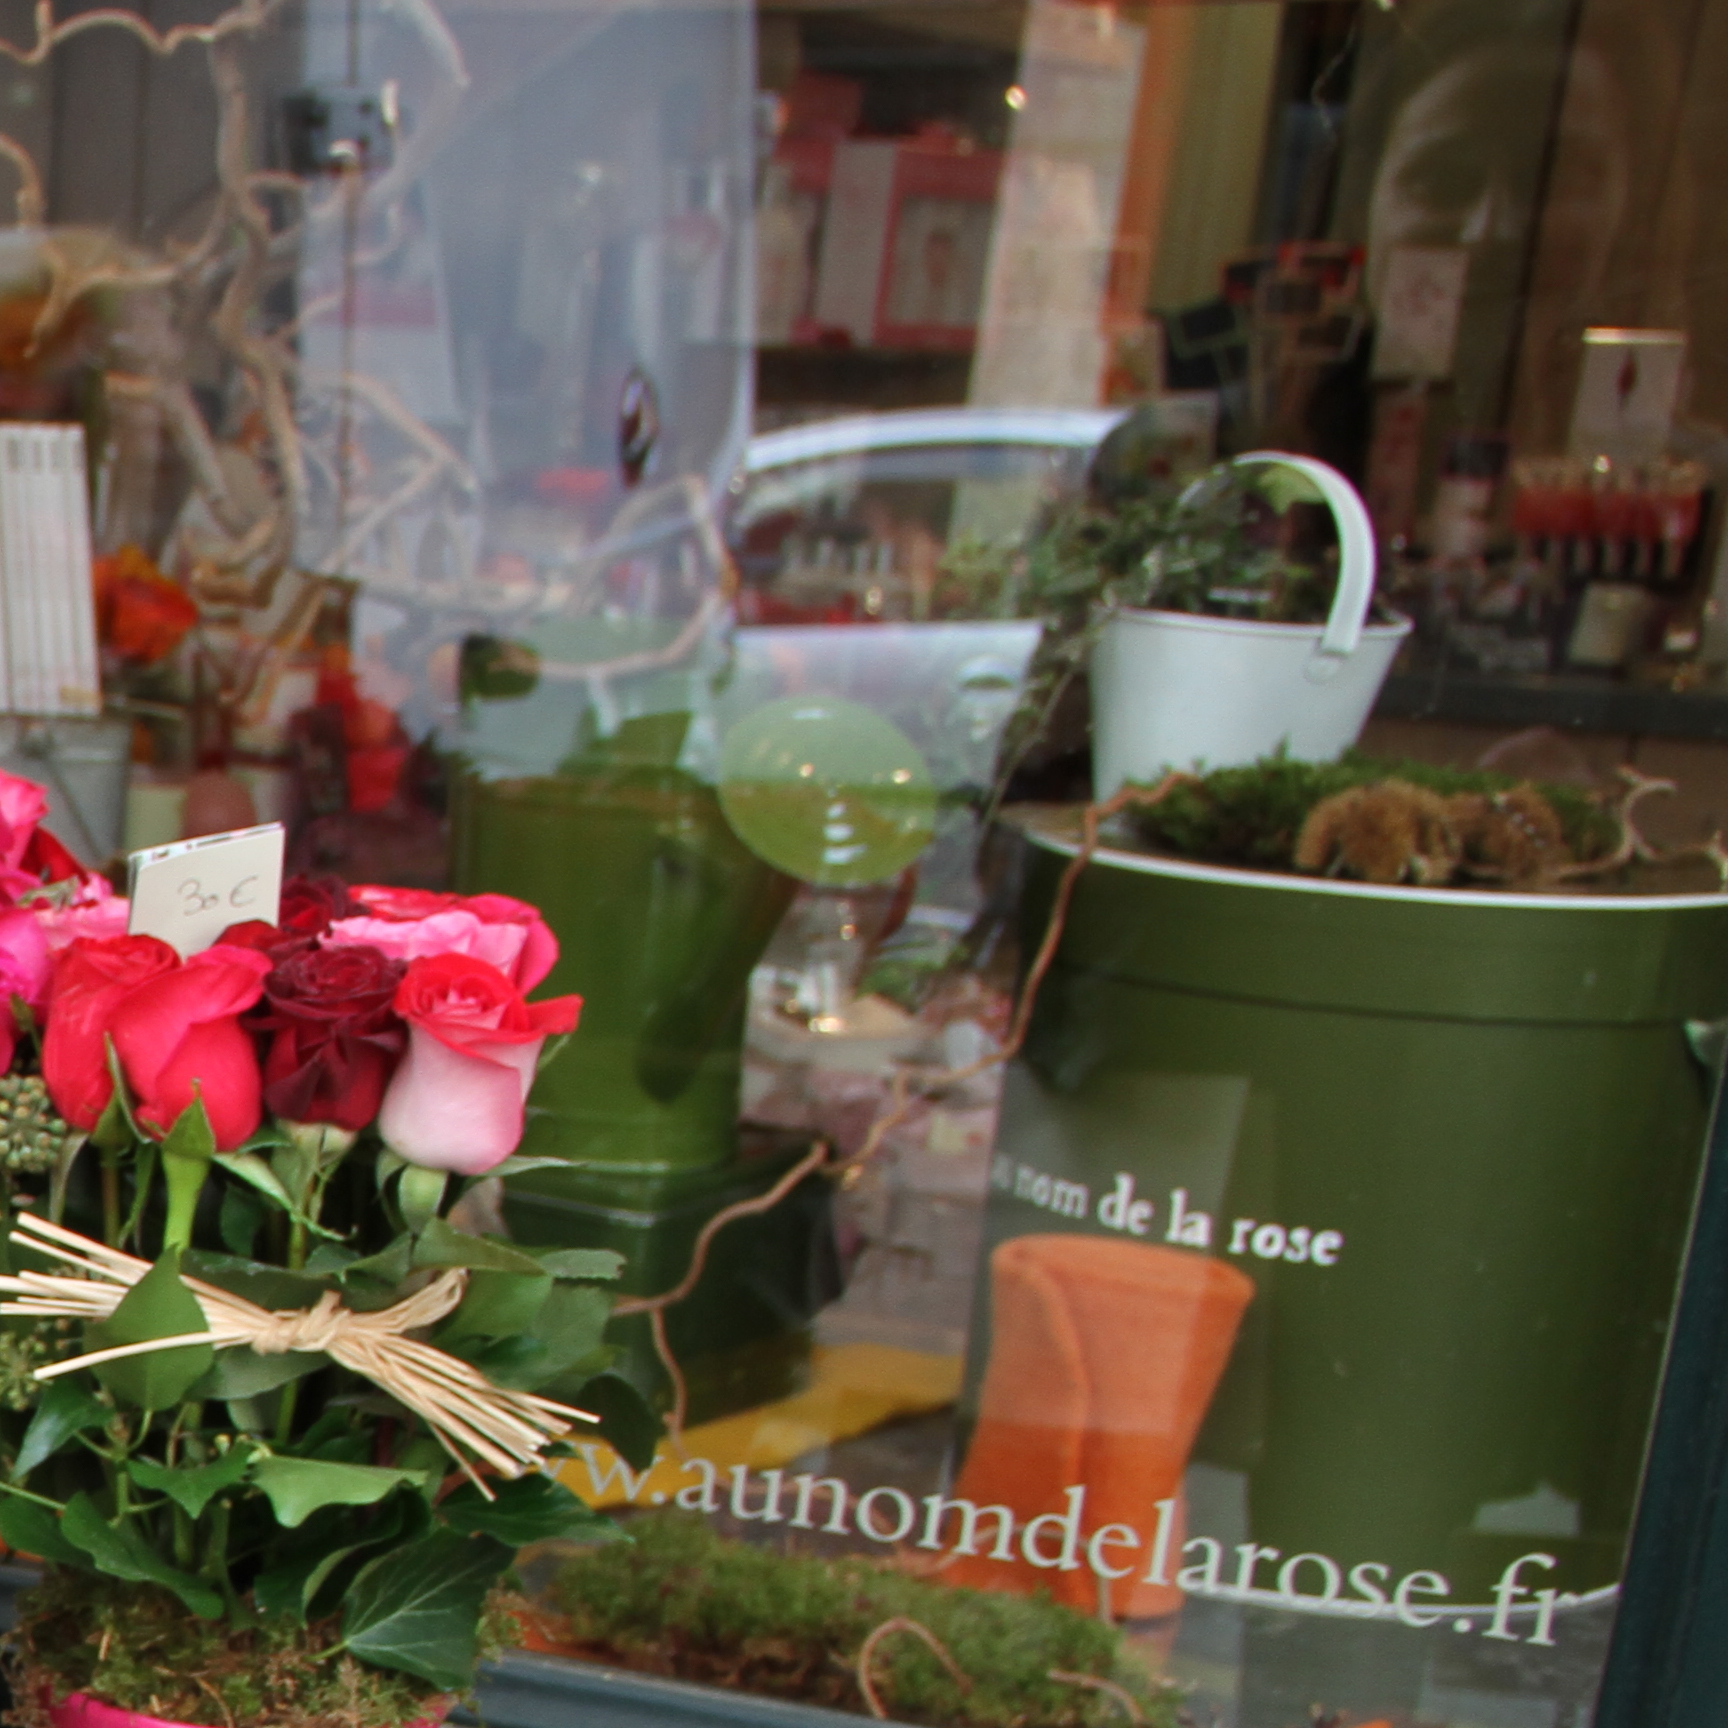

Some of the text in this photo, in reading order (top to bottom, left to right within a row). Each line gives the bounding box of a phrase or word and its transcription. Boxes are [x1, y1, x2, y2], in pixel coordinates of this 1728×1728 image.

[1013, 1161, 1092, 1220] nom
[1096, 1170, 1155, 1236] de
[1163, 1186, 1214, 1249] la
[1227, 1214, 1345, 1267] rose
